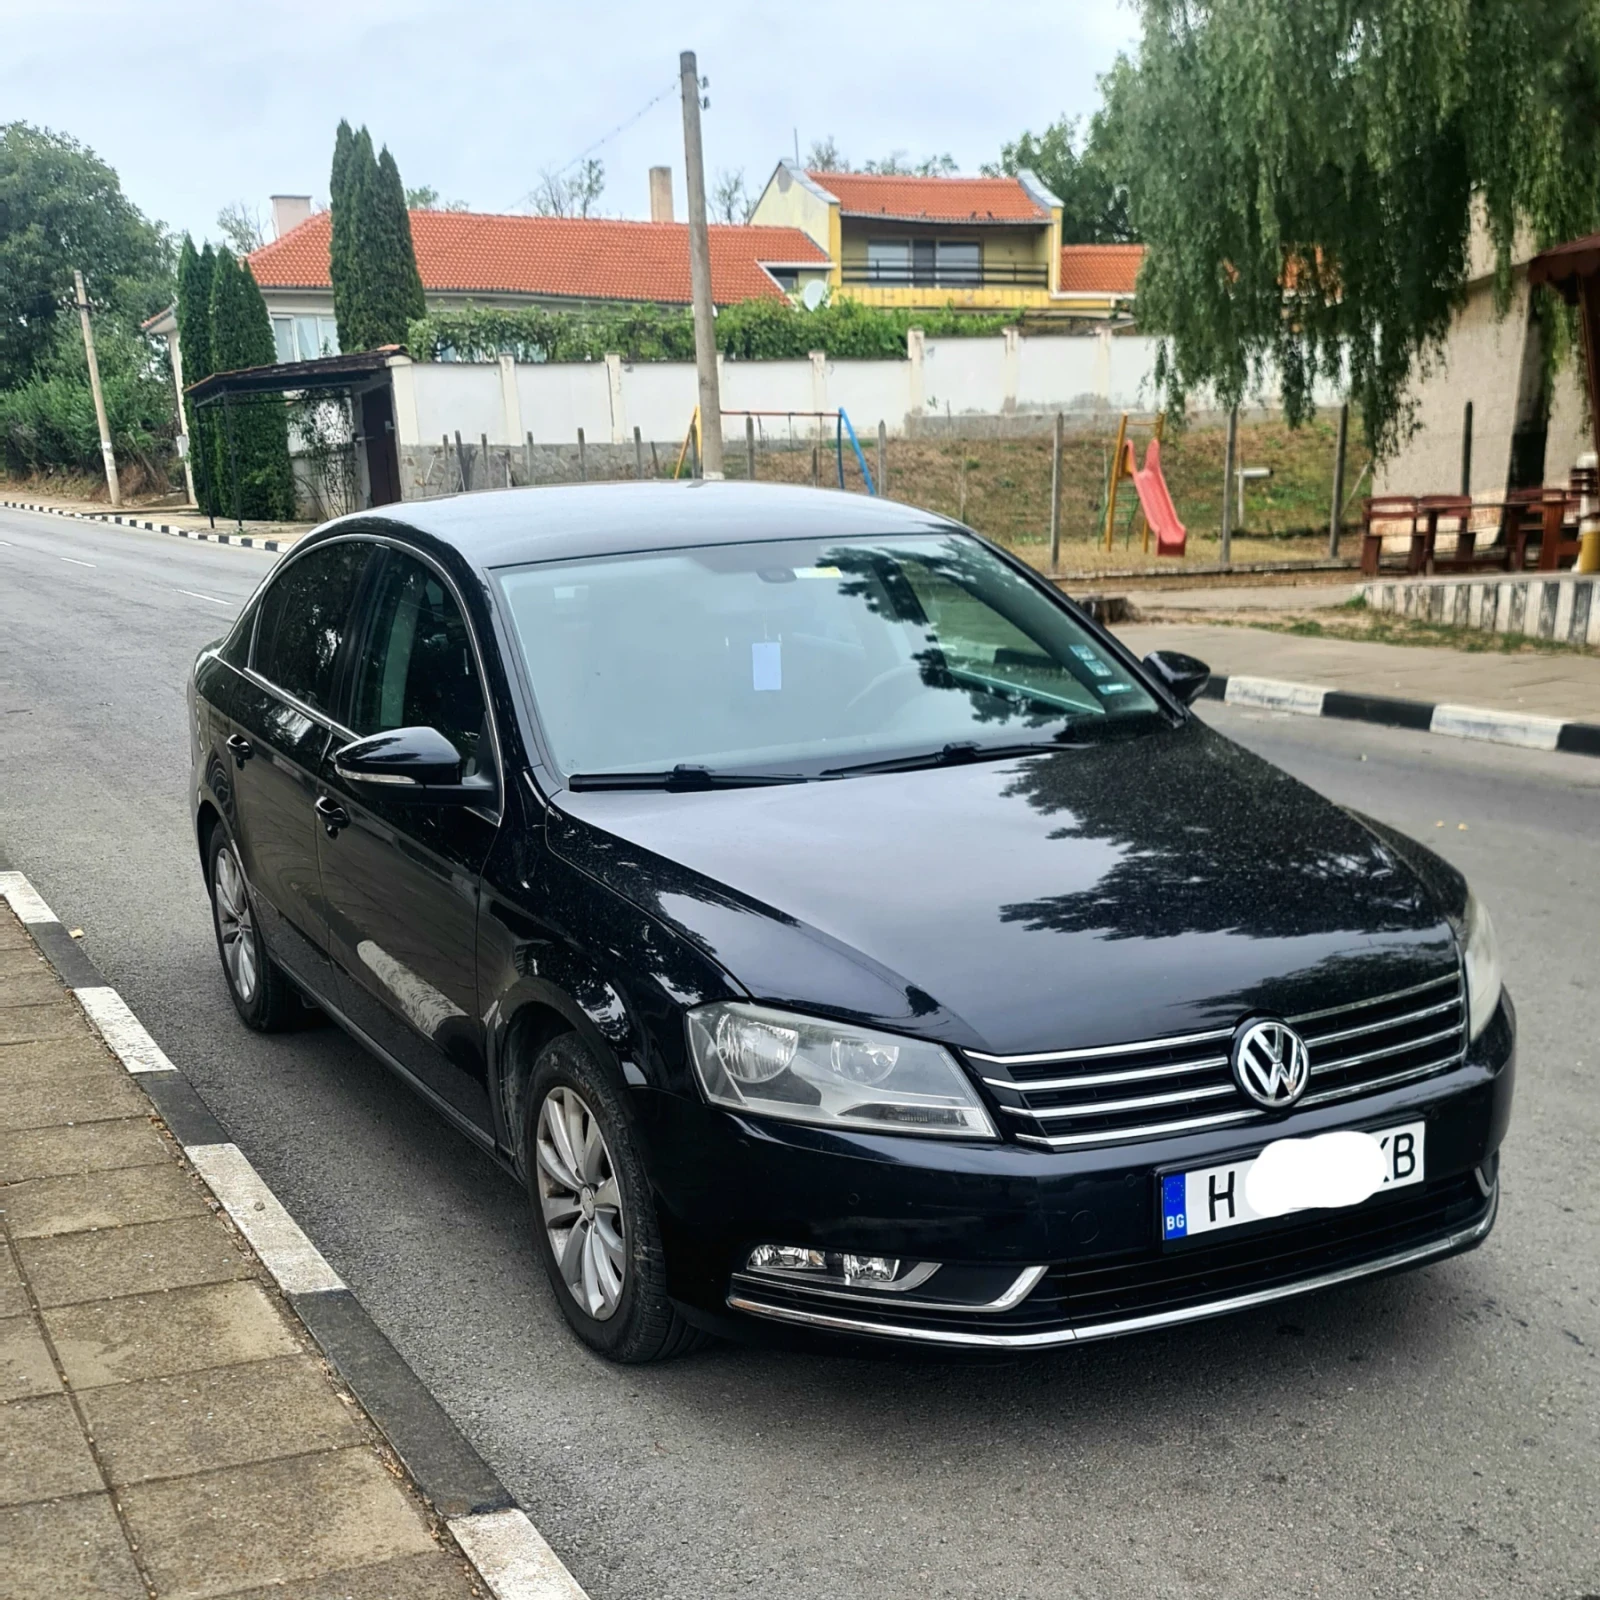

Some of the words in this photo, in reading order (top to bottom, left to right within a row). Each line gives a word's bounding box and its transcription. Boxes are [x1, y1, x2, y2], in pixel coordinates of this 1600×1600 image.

[1240, 1023, 1307, 1105] VW
[1166, 1213, 1185, 1231] BG
[1208, 1171, 1236, 1223] H
